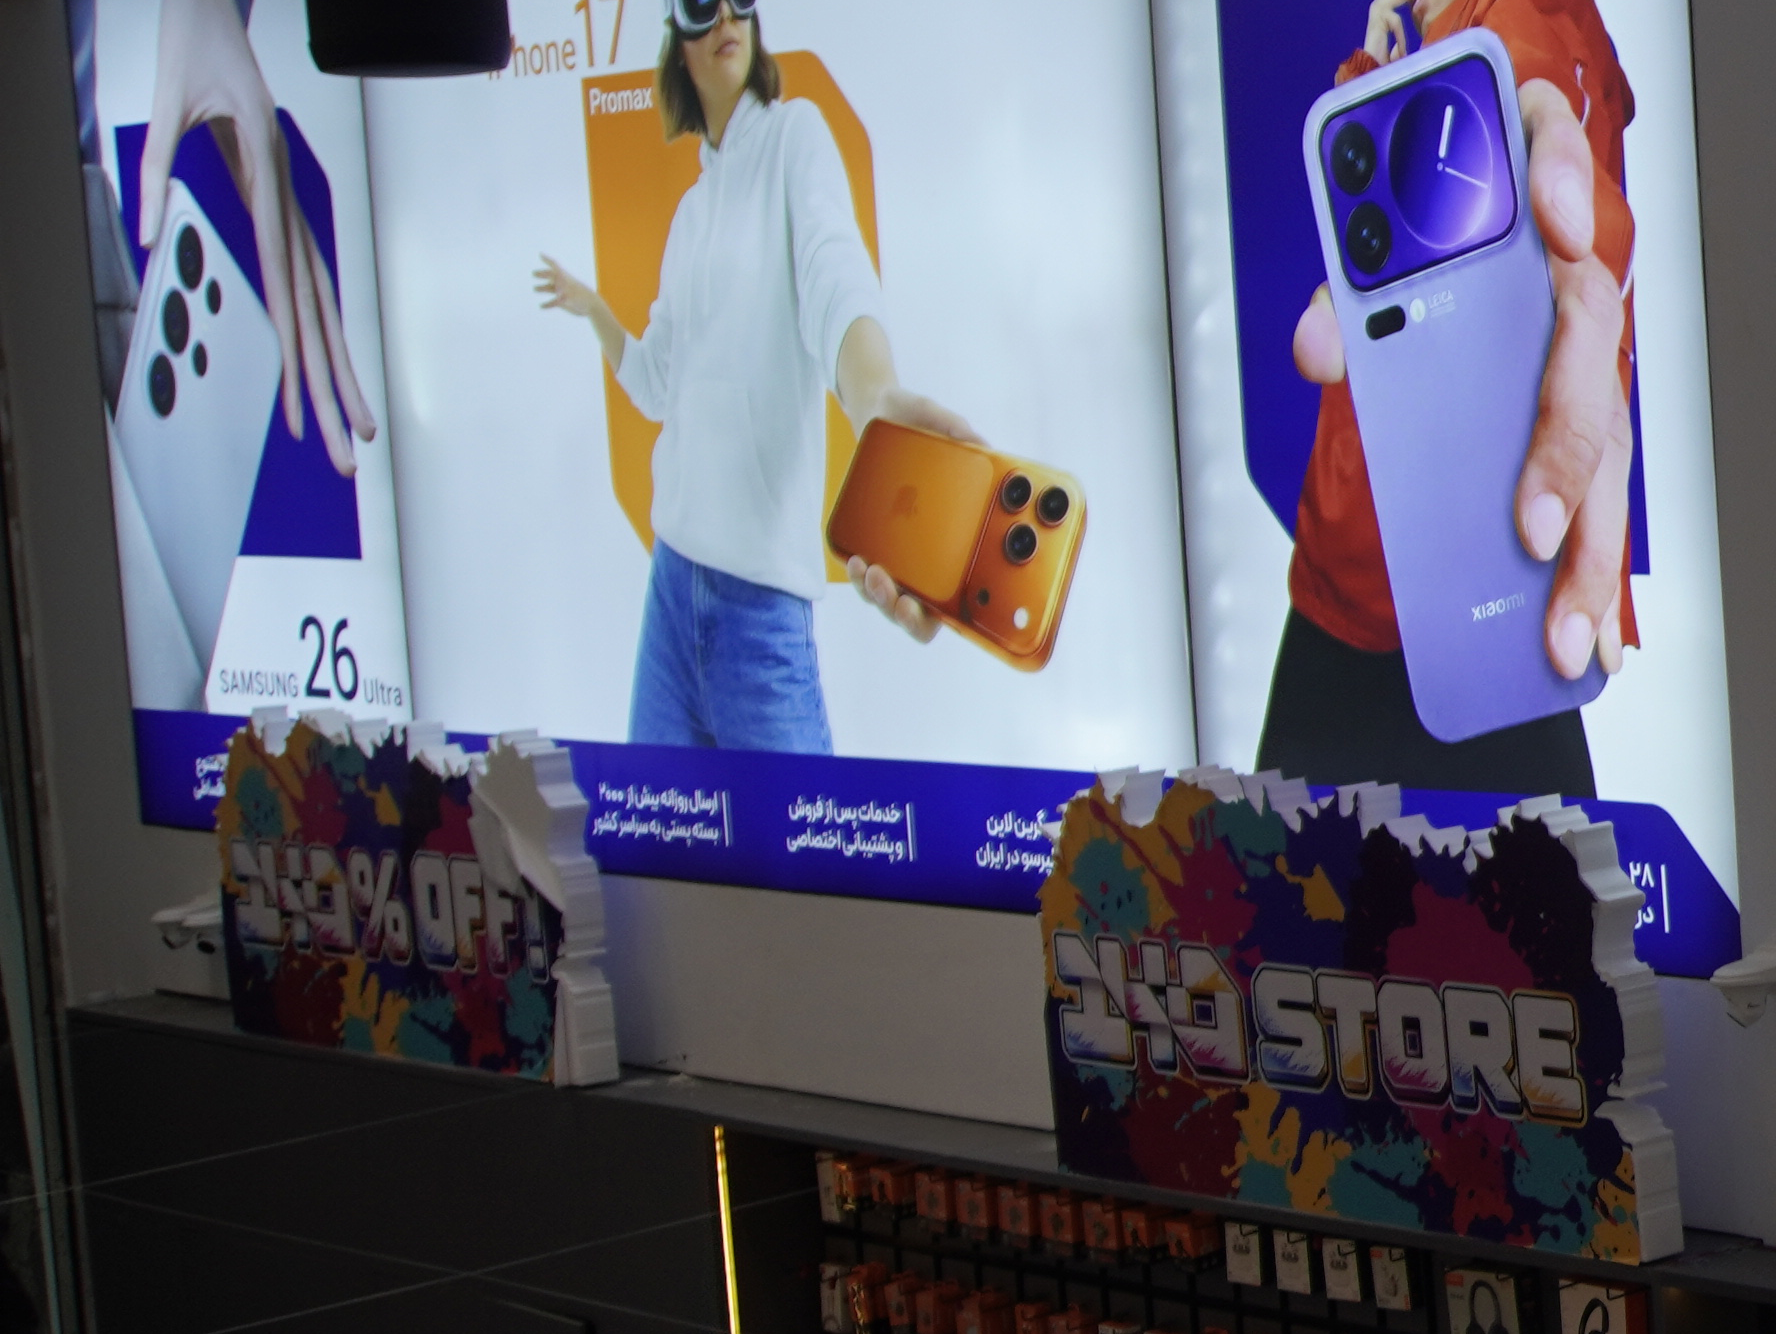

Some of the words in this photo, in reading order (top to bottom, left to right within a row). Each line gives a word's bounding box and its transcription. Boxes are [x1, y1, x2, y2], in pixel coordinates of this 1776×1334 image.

[488, 34, 576, 80] hone
[589, 86, 654, 116] Promax
[219, 669, 299, 698] SAMSUNG
[300, 615, 360, 703] 26
[362, 677, 404, 708] Ultra
[635, 784, 660, 812] بیش
[659, 787, 689, 814] روزانه
[688, 788, 719, 817] ارسال
[788, 793, 824, 824] فروش
[858, 799, 901, 824] خدمات
[592, 810, 620, 836] کشور
[833, 806, 858, 830] پس
[691, 821, 719, 847] بسته
[786, 826, 841, 853] اختصاصی
[976, 841, 1005, 870] ایران
[1004, 848, 1021, 871] در
[1252, 962, 1588, 1128] STORE
